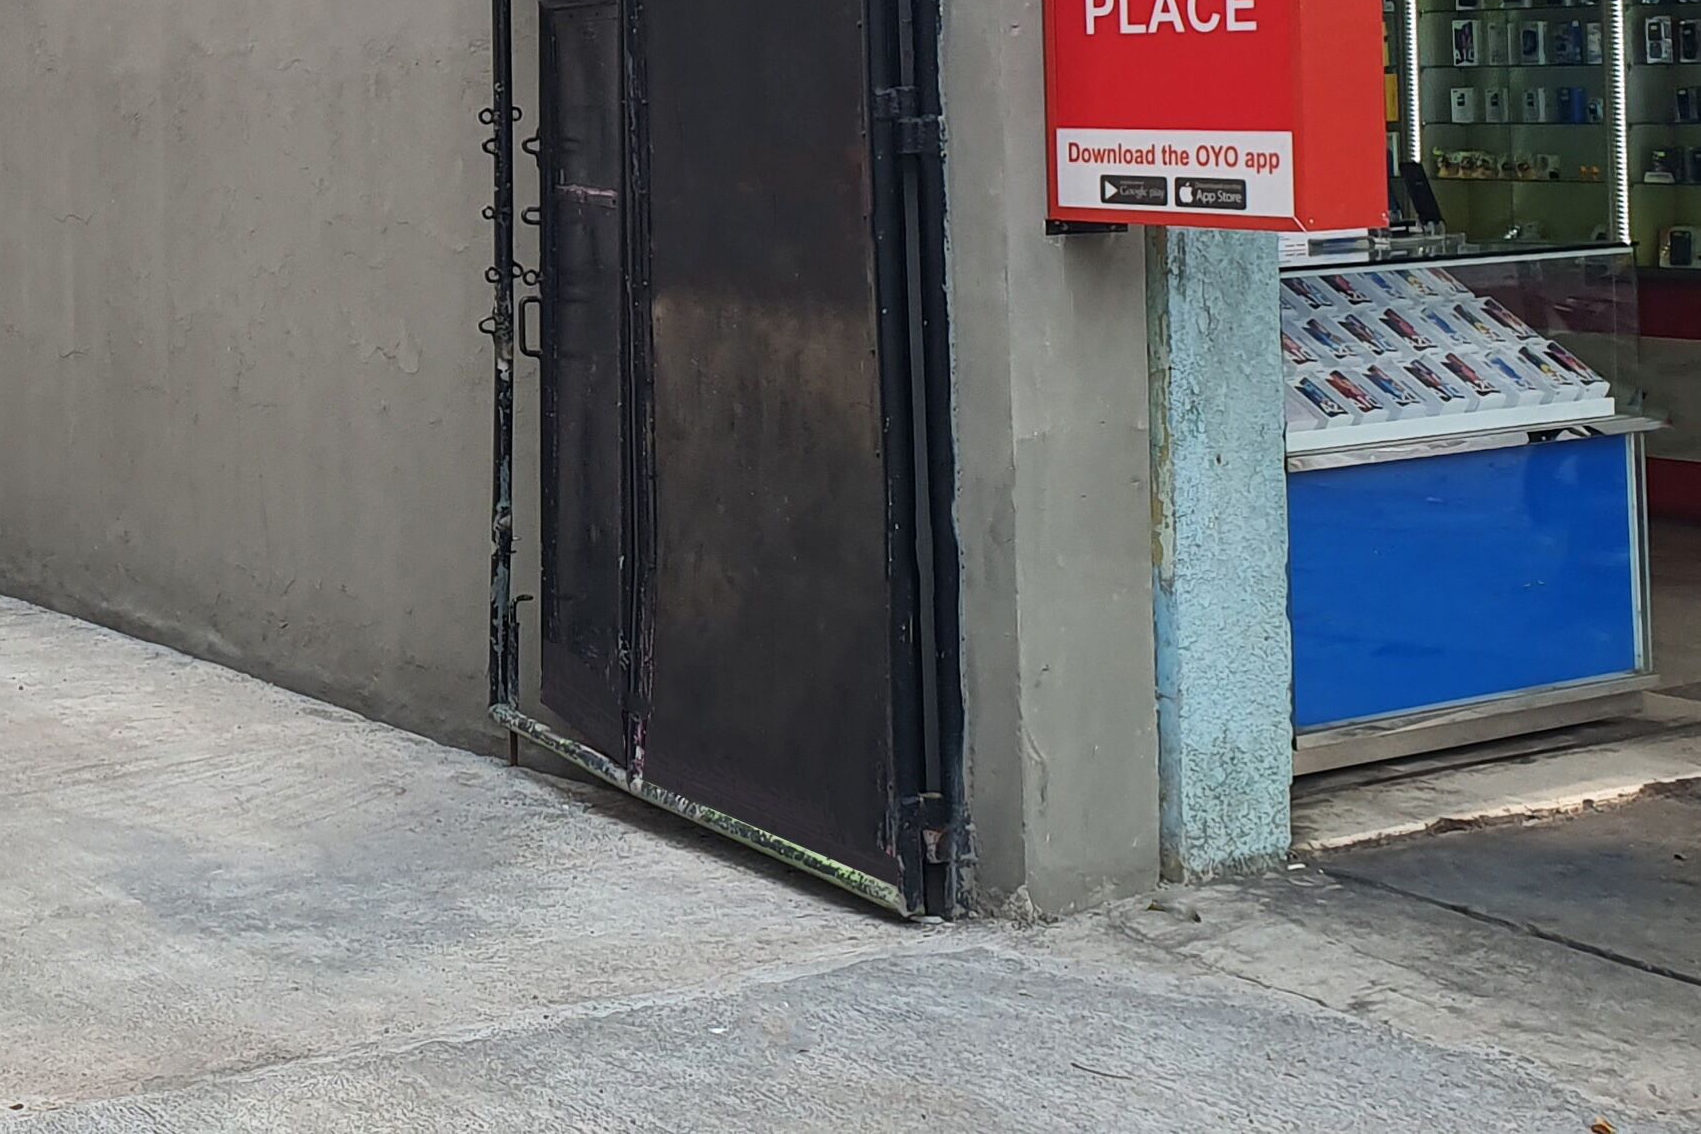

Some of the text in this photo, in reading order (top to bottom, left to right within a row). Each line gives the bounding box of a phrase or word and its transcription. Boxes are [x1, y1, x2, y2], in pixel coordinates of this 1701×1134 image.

[1067, 142, 1281, 175] Download the OYO app
[1196, 188, 1242, 204] App Store
